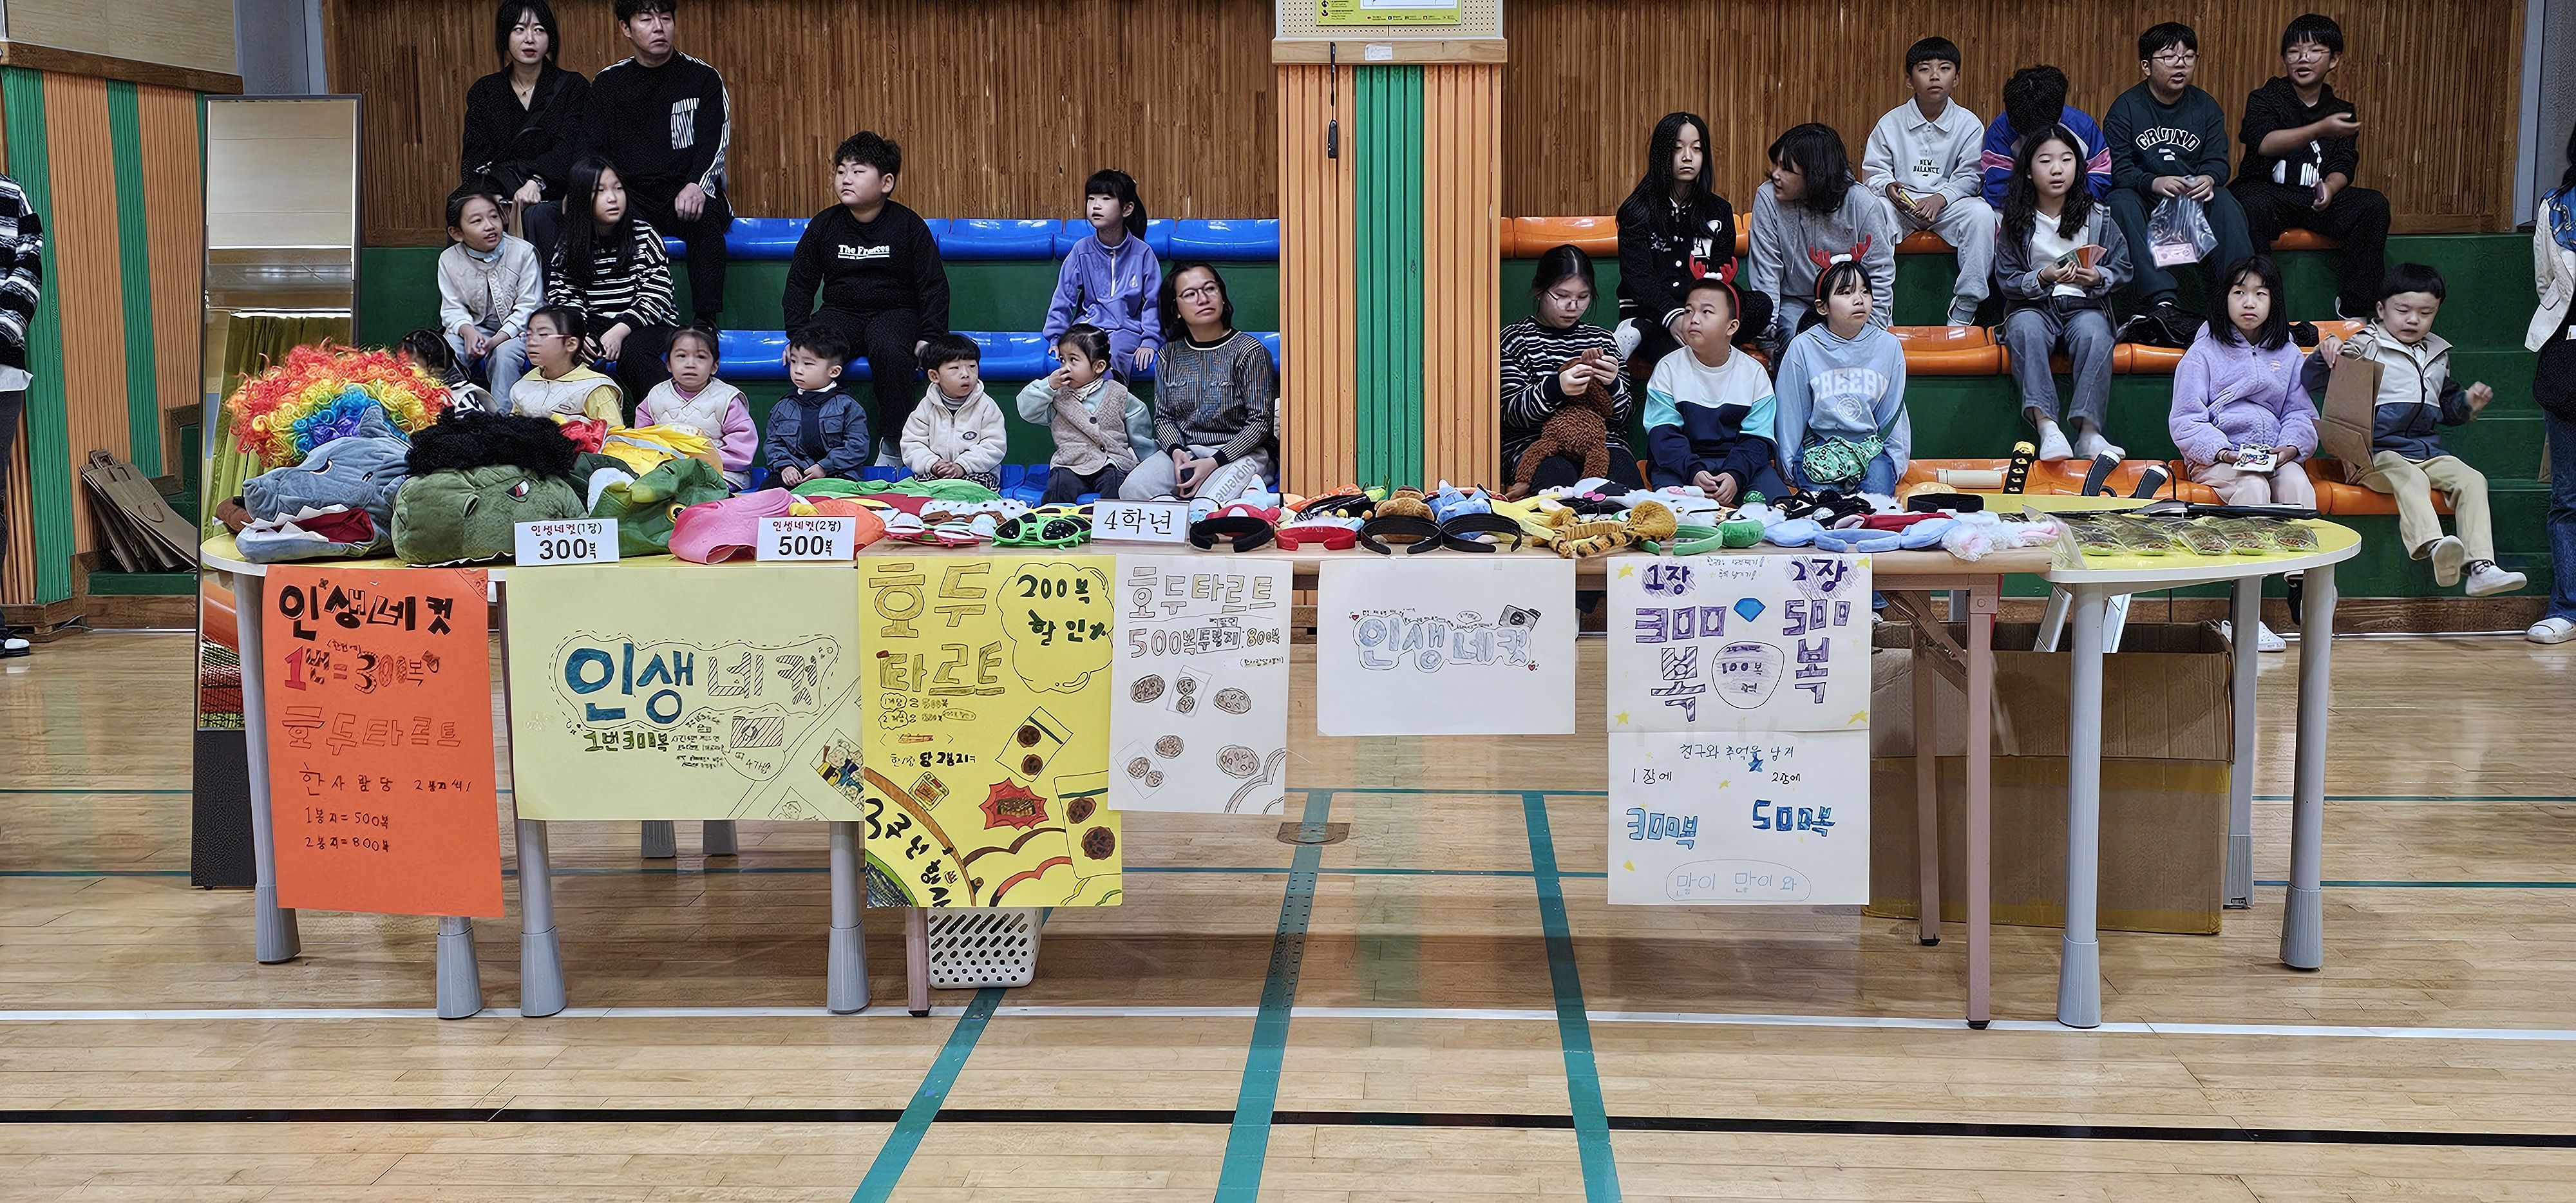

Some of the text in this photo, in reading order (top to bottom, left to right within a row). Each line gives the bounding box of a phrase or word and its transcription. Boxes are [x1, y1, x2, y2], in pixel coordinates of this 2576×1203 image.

[838, 244, 856, 254] The
[1215, 458, 1257, 503] Supreme
[531, 522, 602, 535] 인생네컷(1장)
[773, 519, 841, 533] 인생네컷(2장)
[1104, 508, 1171, 535] 4학년
[539, 538, 596, 560] 300복
[778, 535, 832, 556] 500복
[1016, 574, 1090, 604] 200복
[1644, 564, 1690, 594] 1장
[1792, 557, 1848, 592] 2장
[869, 562, 991, 638] 호두
[1128, 566, 1276, 619] 호두타르트
[278, 583, 453, 641] 인생네컷
[1634, 605, 1727, 643] 300
[1128, 627, 1196, 658] 500복
[1198, 628, 1238, 651] 두봉지
[1358, 617, 1527, 670] 인생네컷
[564, 642, 818, 725] 인생네컷
[880, 641, 1005, 696] 타르트
[1651, 646, 1706, 722] 복
[1794, 637, 1830, 704] 복
[282, 706, 462, 757] 호두타르트
[1680, 744, 1719, 759] 친구와
[1632, 768, 1672, 784] 1장에
[1772, 772, 1801, 784] 2장에
[1626, 807, 1700, 850] 300복
[1752, 799, 1836, 837] 500복
[1676, 870, 1797, 896] 많이 많이 와
